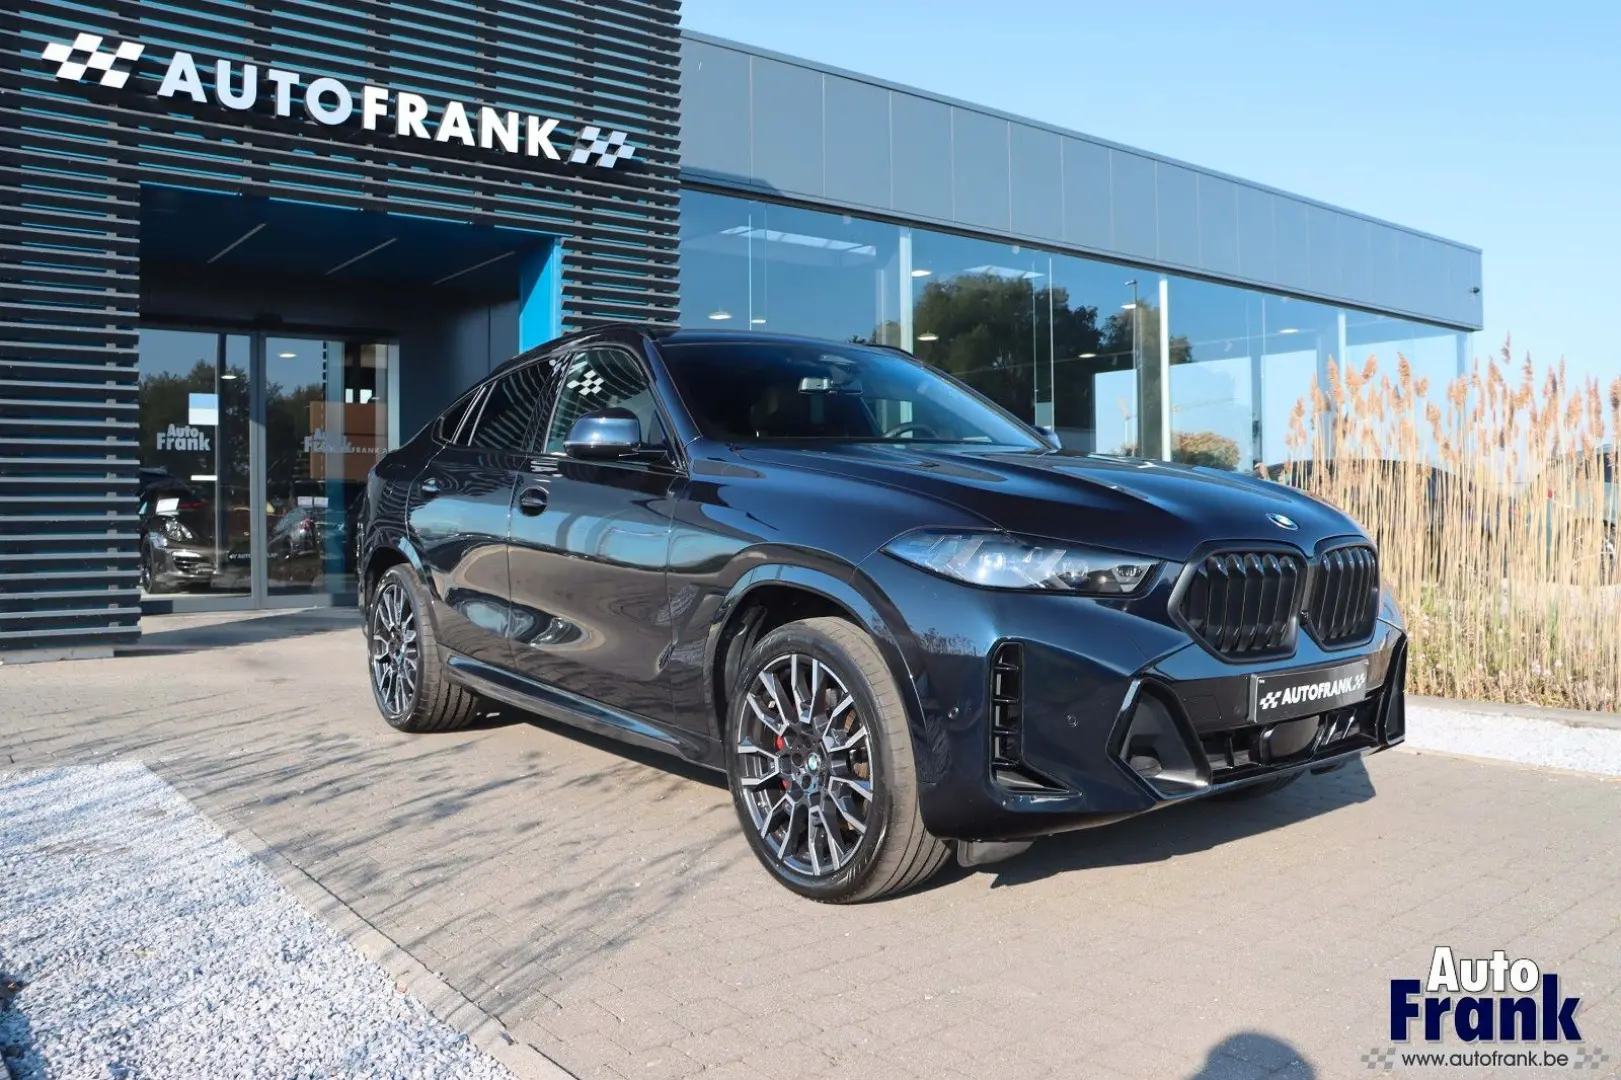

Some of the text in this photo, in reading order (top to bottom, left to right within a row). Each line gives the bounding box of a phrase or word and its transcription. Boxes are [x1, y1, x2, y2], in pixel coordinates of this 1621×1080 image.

[157, 51, 561, 160] AUTOFRANK
[156, 432, 210, 451] Frank
[167, 423, 199, 438] Auto
[1281, 677, 1352, 704] AUTOFRANK
